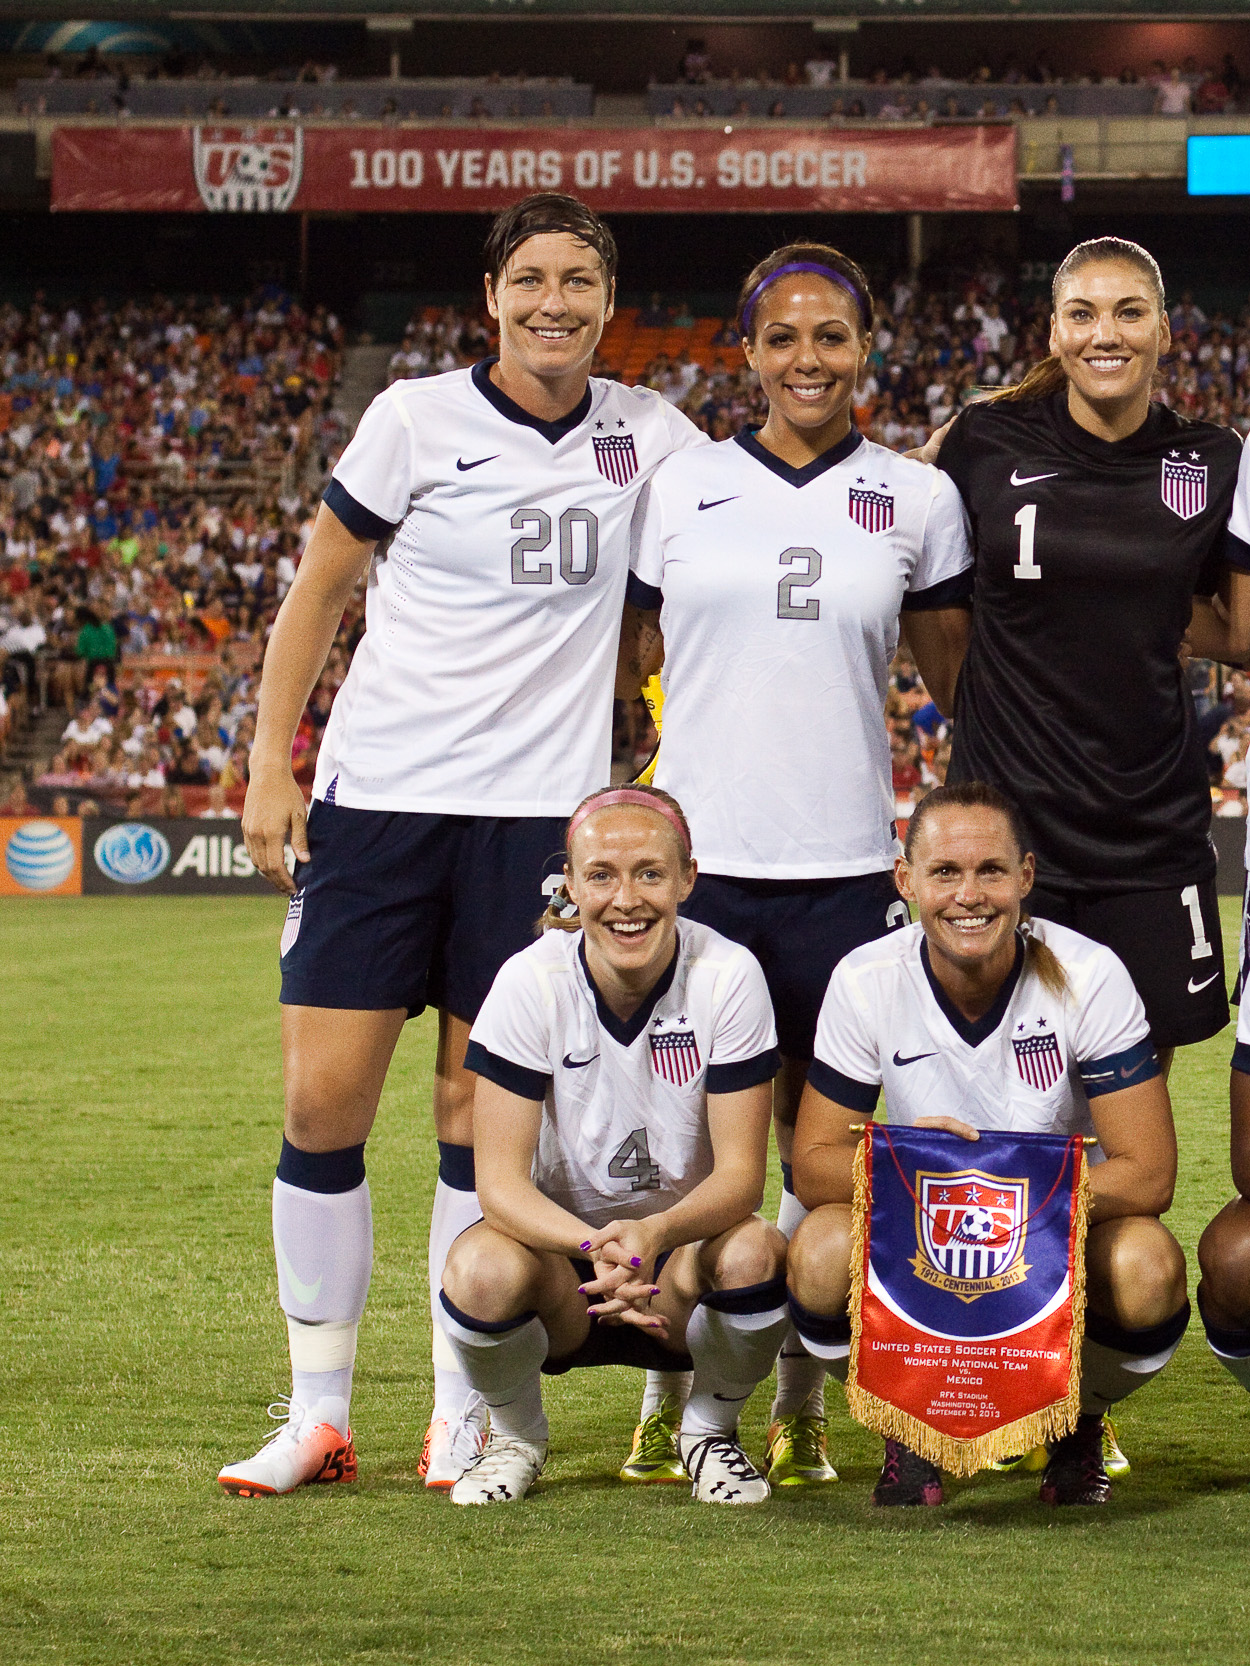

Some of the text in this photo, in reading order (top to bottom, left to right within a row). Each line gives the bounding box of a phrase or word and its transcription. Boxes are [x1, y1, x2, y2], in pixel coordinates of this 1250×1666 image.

[350, 149, 868, 188] 100 YEARS OF U.S. SOCCER
[510, 507, 599, 585] 20
[1013, 504, 1042, 579] 1
[777, 546, 822, 620] 2
[1181, 884, 1213, 960] 1
[608, 1127, 660, 1192] 4
[932, 1208, 1012, 1249] US
[920, 1266, 939, 1284] 1913
[943, 1279, 996, 1292] CENTENNIAL
[1000, 1271, 1020, 1287] 2013
[872, 1341, 1061, 1360] UNITED STATES SOCCER FEDERATION
[904, 1356, 1028, 1371] WOMEN'S NATIONAL TEAM
[940, 1391, 989, 1400] RFK STADIUM
[946, 1375, 983, 1385] MEXICO
[926, 1407, 967, 1416] SEPTEMBER
[979, 1410, 1000, 1418] 2013
